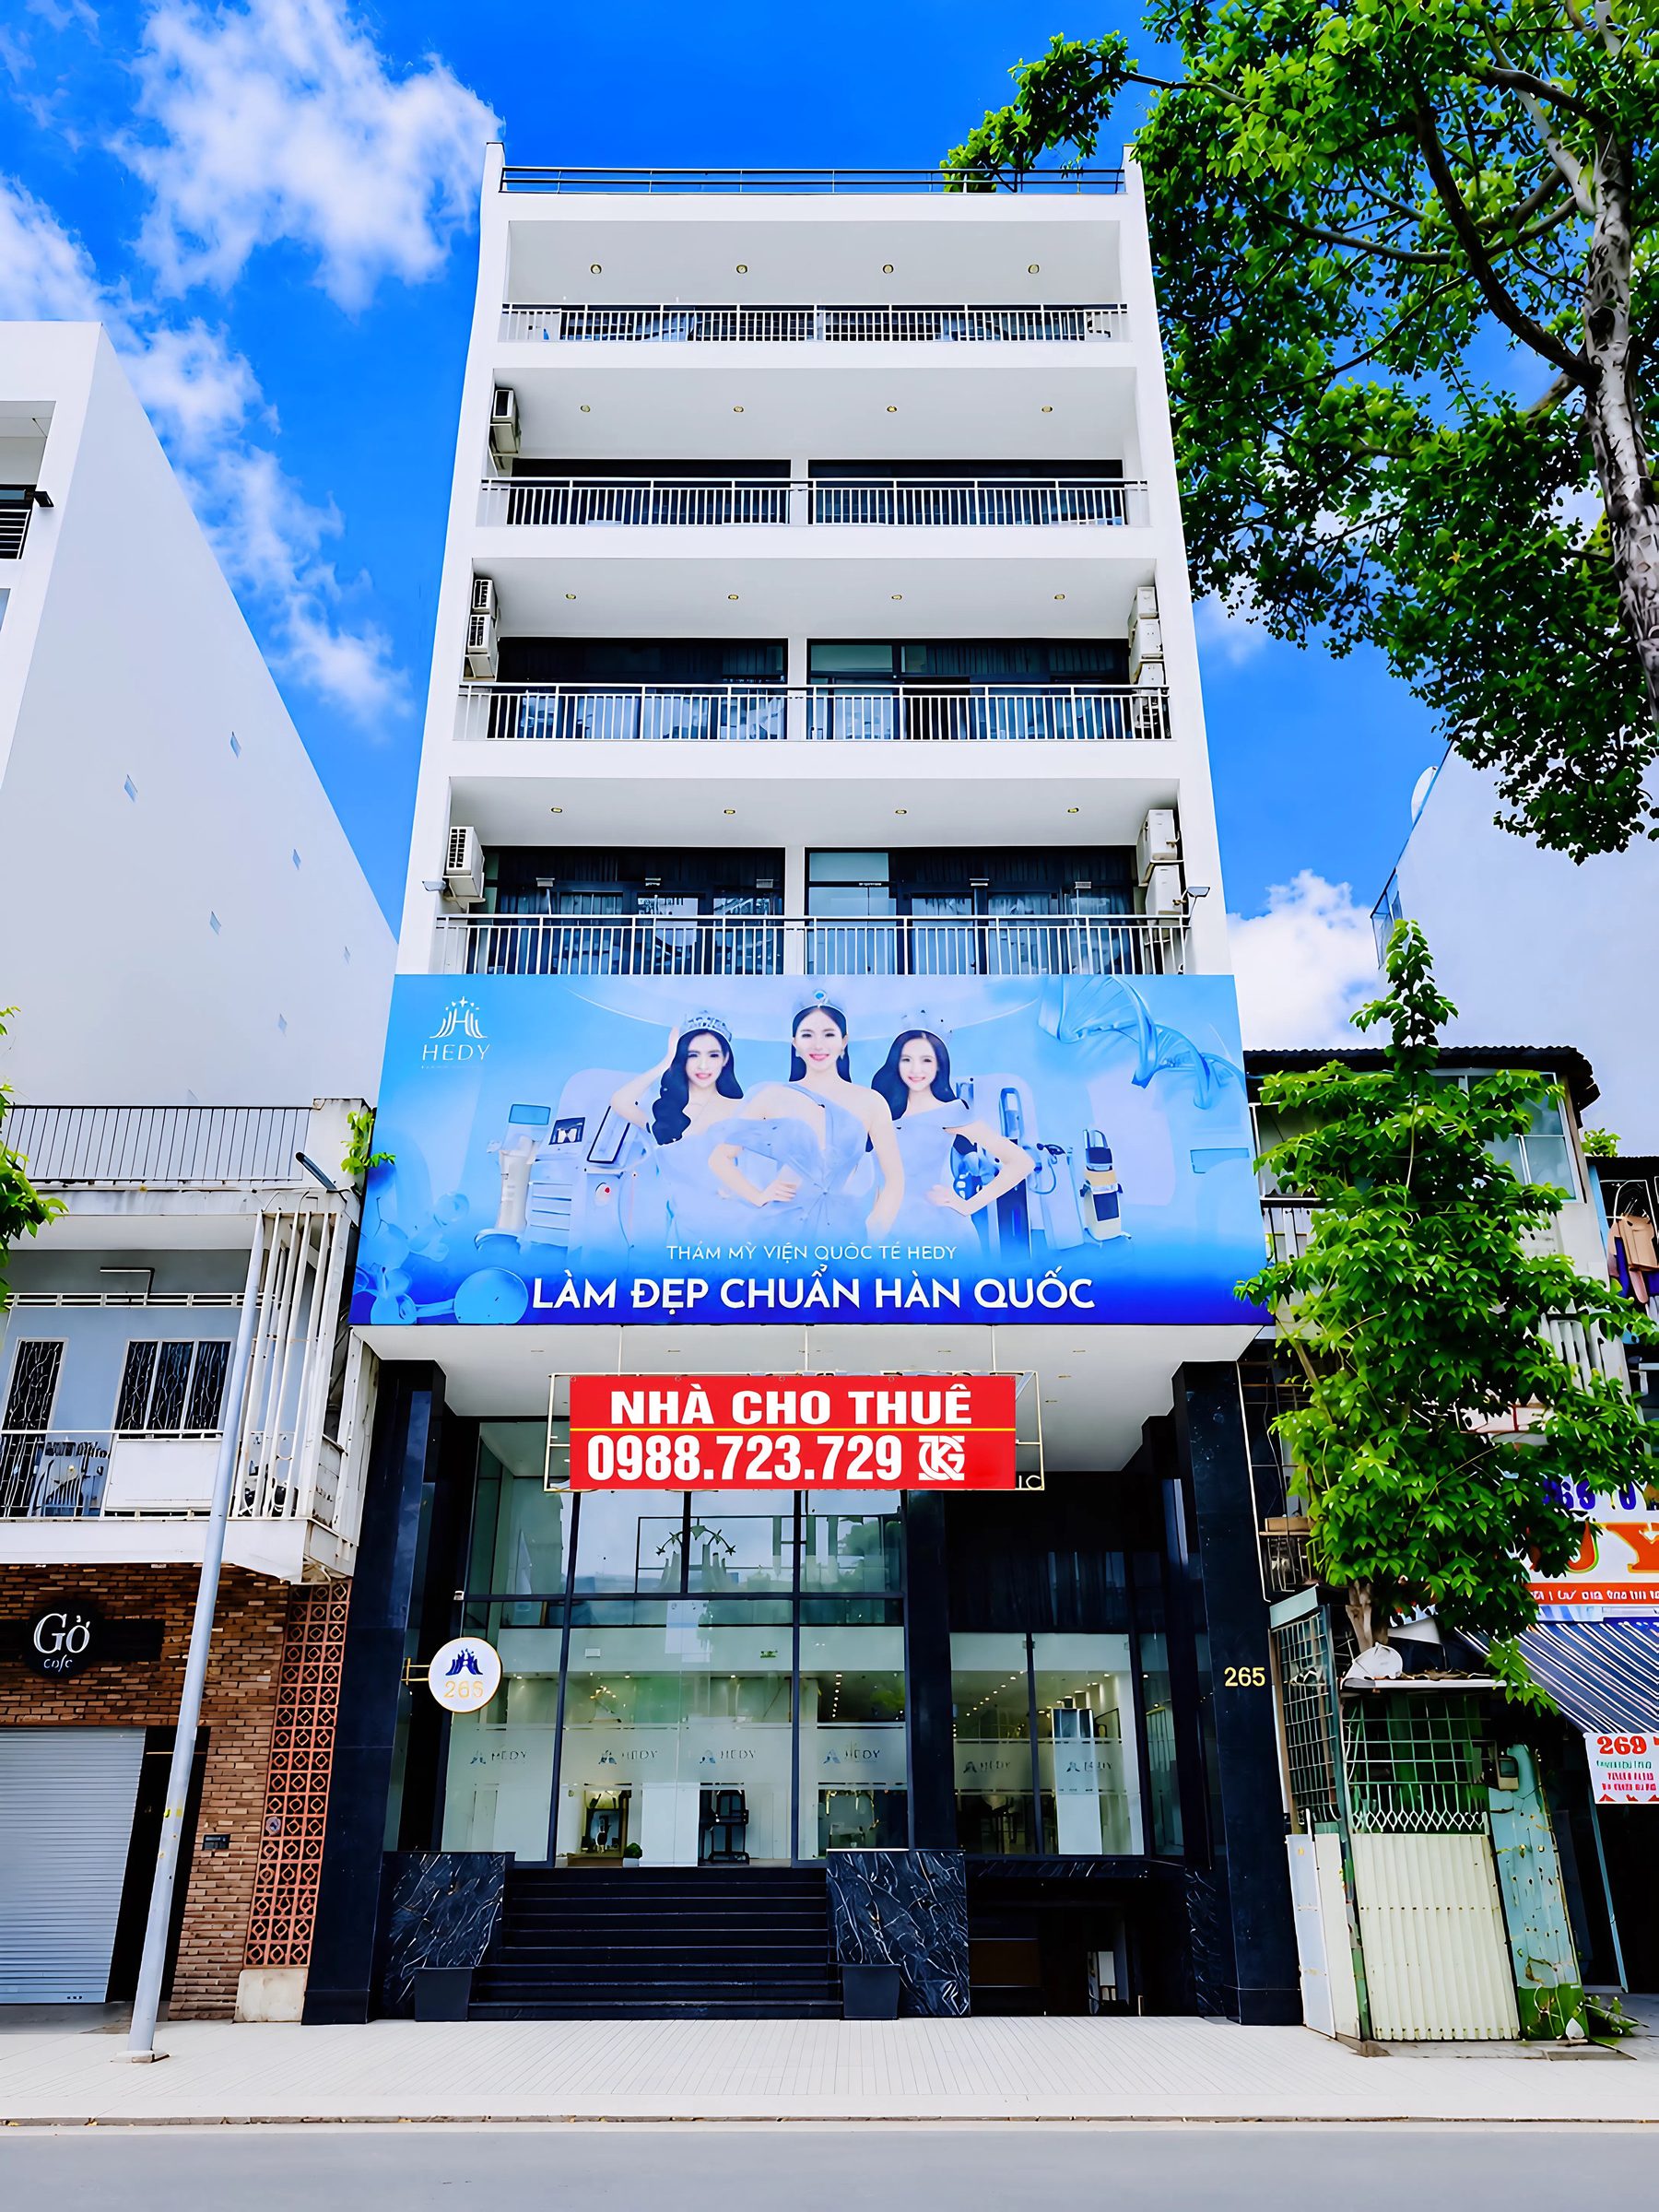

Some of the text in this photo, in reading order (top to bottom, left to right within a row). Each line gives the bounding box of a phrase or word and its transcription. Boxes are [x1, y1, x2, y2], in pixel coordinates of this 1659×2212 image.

[422, 1043, 490, 1061] HEDY
[907, 1244, 957, 1260] HEDY
[532, 1262, 1095, 1315] LÀM ĐẸP CHUẨN HÀN QUỐC
[610, 1383, 972, 1425] NHÀ CHO THUÊ
[587, 1434, 902, 1481] 0988.723.729
[33, 1613, 90, 1654] Gở
[1224, 1666, 1265, 1687] 265
[1596, 1735, 1647, 1755] 269
